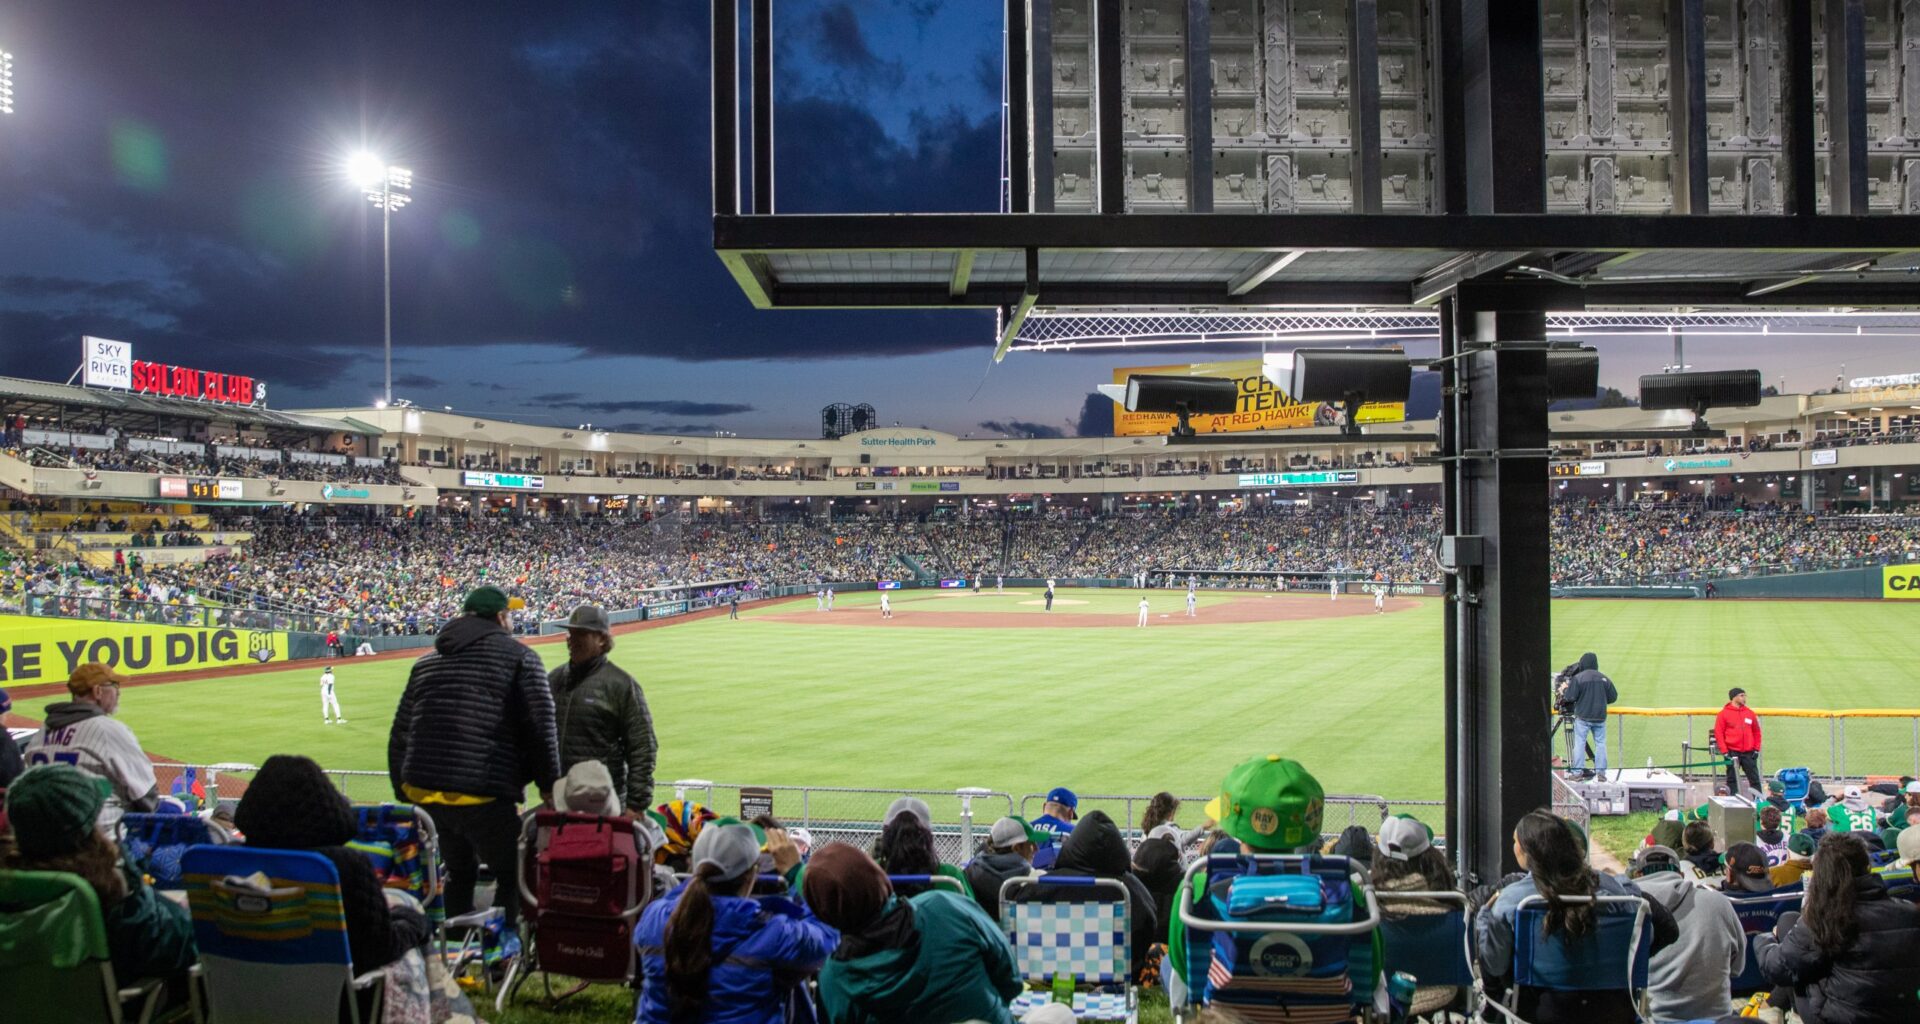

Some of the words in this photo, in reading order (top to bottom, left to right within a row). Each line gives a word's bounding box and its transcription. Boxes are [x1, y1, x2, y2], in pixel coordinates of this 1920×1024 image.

[98, 343, 122, 358] SKY
[91, 361, 128, 378] RIVER
[132, 360, 199, 397] SOLON
[205, 371, 253, 403] CLUB
[1122, 413, 1172, 421] REDHAWK
[1212, 416, 1229, 427] AT
[1232, 412, 1261, 425] RED
[1265, 405, 1310, 421] HAWK!
[861, 437, 887, 446] Sutter
[889, 437, 916, 446] Health
[917, 437, 937, 446] Park
[1574, 465, 1580, 475] 0
[193, 484, 200, 497] 4
[212, 484, 219, 498] 0
[1370, 583, 1395, 593] Sttr
[1397, 583, 1424, 594] Health
[1889, 575, 1920, 591] CA
[250, 631, 274, 651] 811
[0, 642, 42, 681] E
[57, 635, 152, 675] YOU
[166, 629, 239, 667] DIG
[1849, 814, 1874, 832] 26
